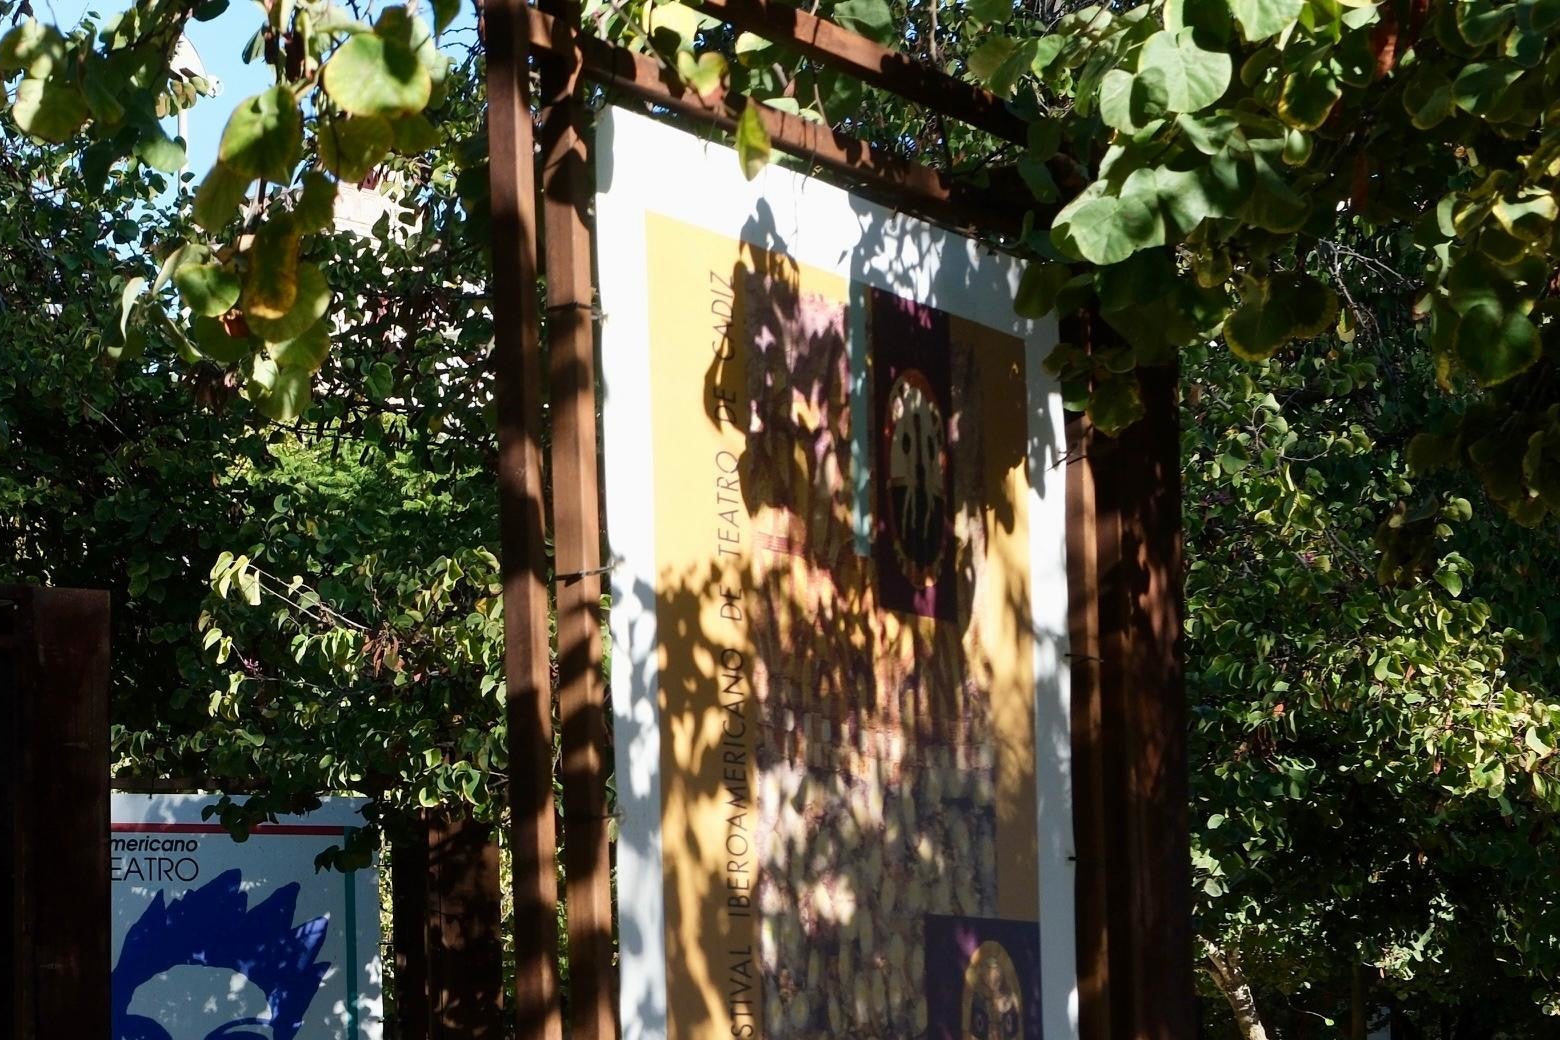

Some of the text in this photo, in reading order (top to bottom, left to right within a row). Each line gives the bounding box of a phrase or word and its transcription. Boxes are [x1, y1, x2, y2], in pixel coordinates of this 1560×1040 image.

[710, 270, 737, 361] CADIZ
[713, 386, 737, 423] DE
[715, 451, 742, 560] TEATRO
[720, 584, 743, 621] DE
[721, 648, 751, 918] IBEROAMERICANO
